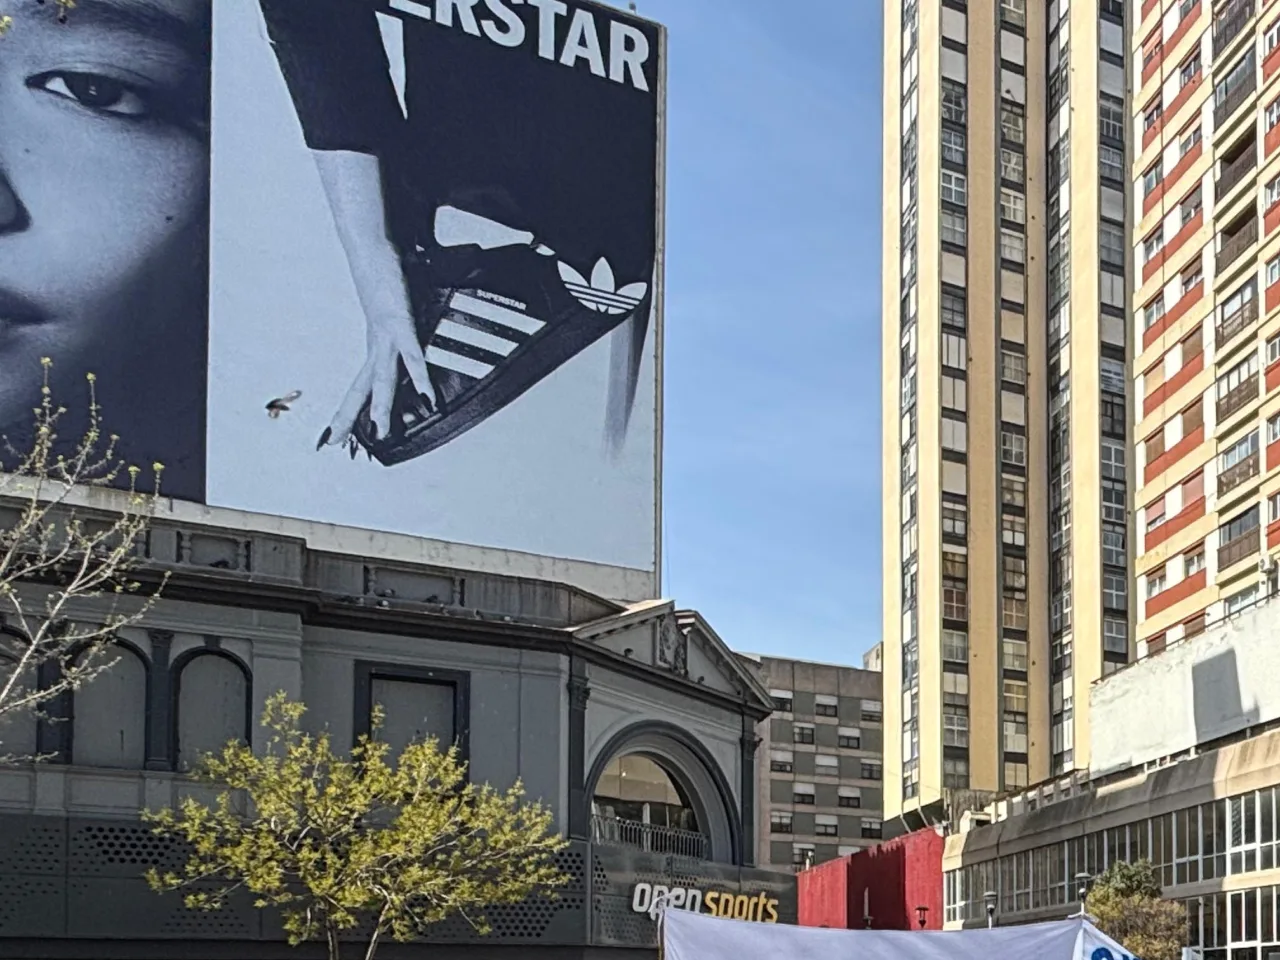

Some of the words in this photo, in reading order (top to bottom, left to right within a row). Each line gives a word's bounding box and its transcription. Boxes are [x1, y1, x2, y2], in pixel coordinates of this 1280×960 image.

[390, 0, 649, 92] RSTAR
[476, 288, 527, 311] SUPERSTAR
[632, 883, 702, 921] open
[704, 890, 779, 924] sports
